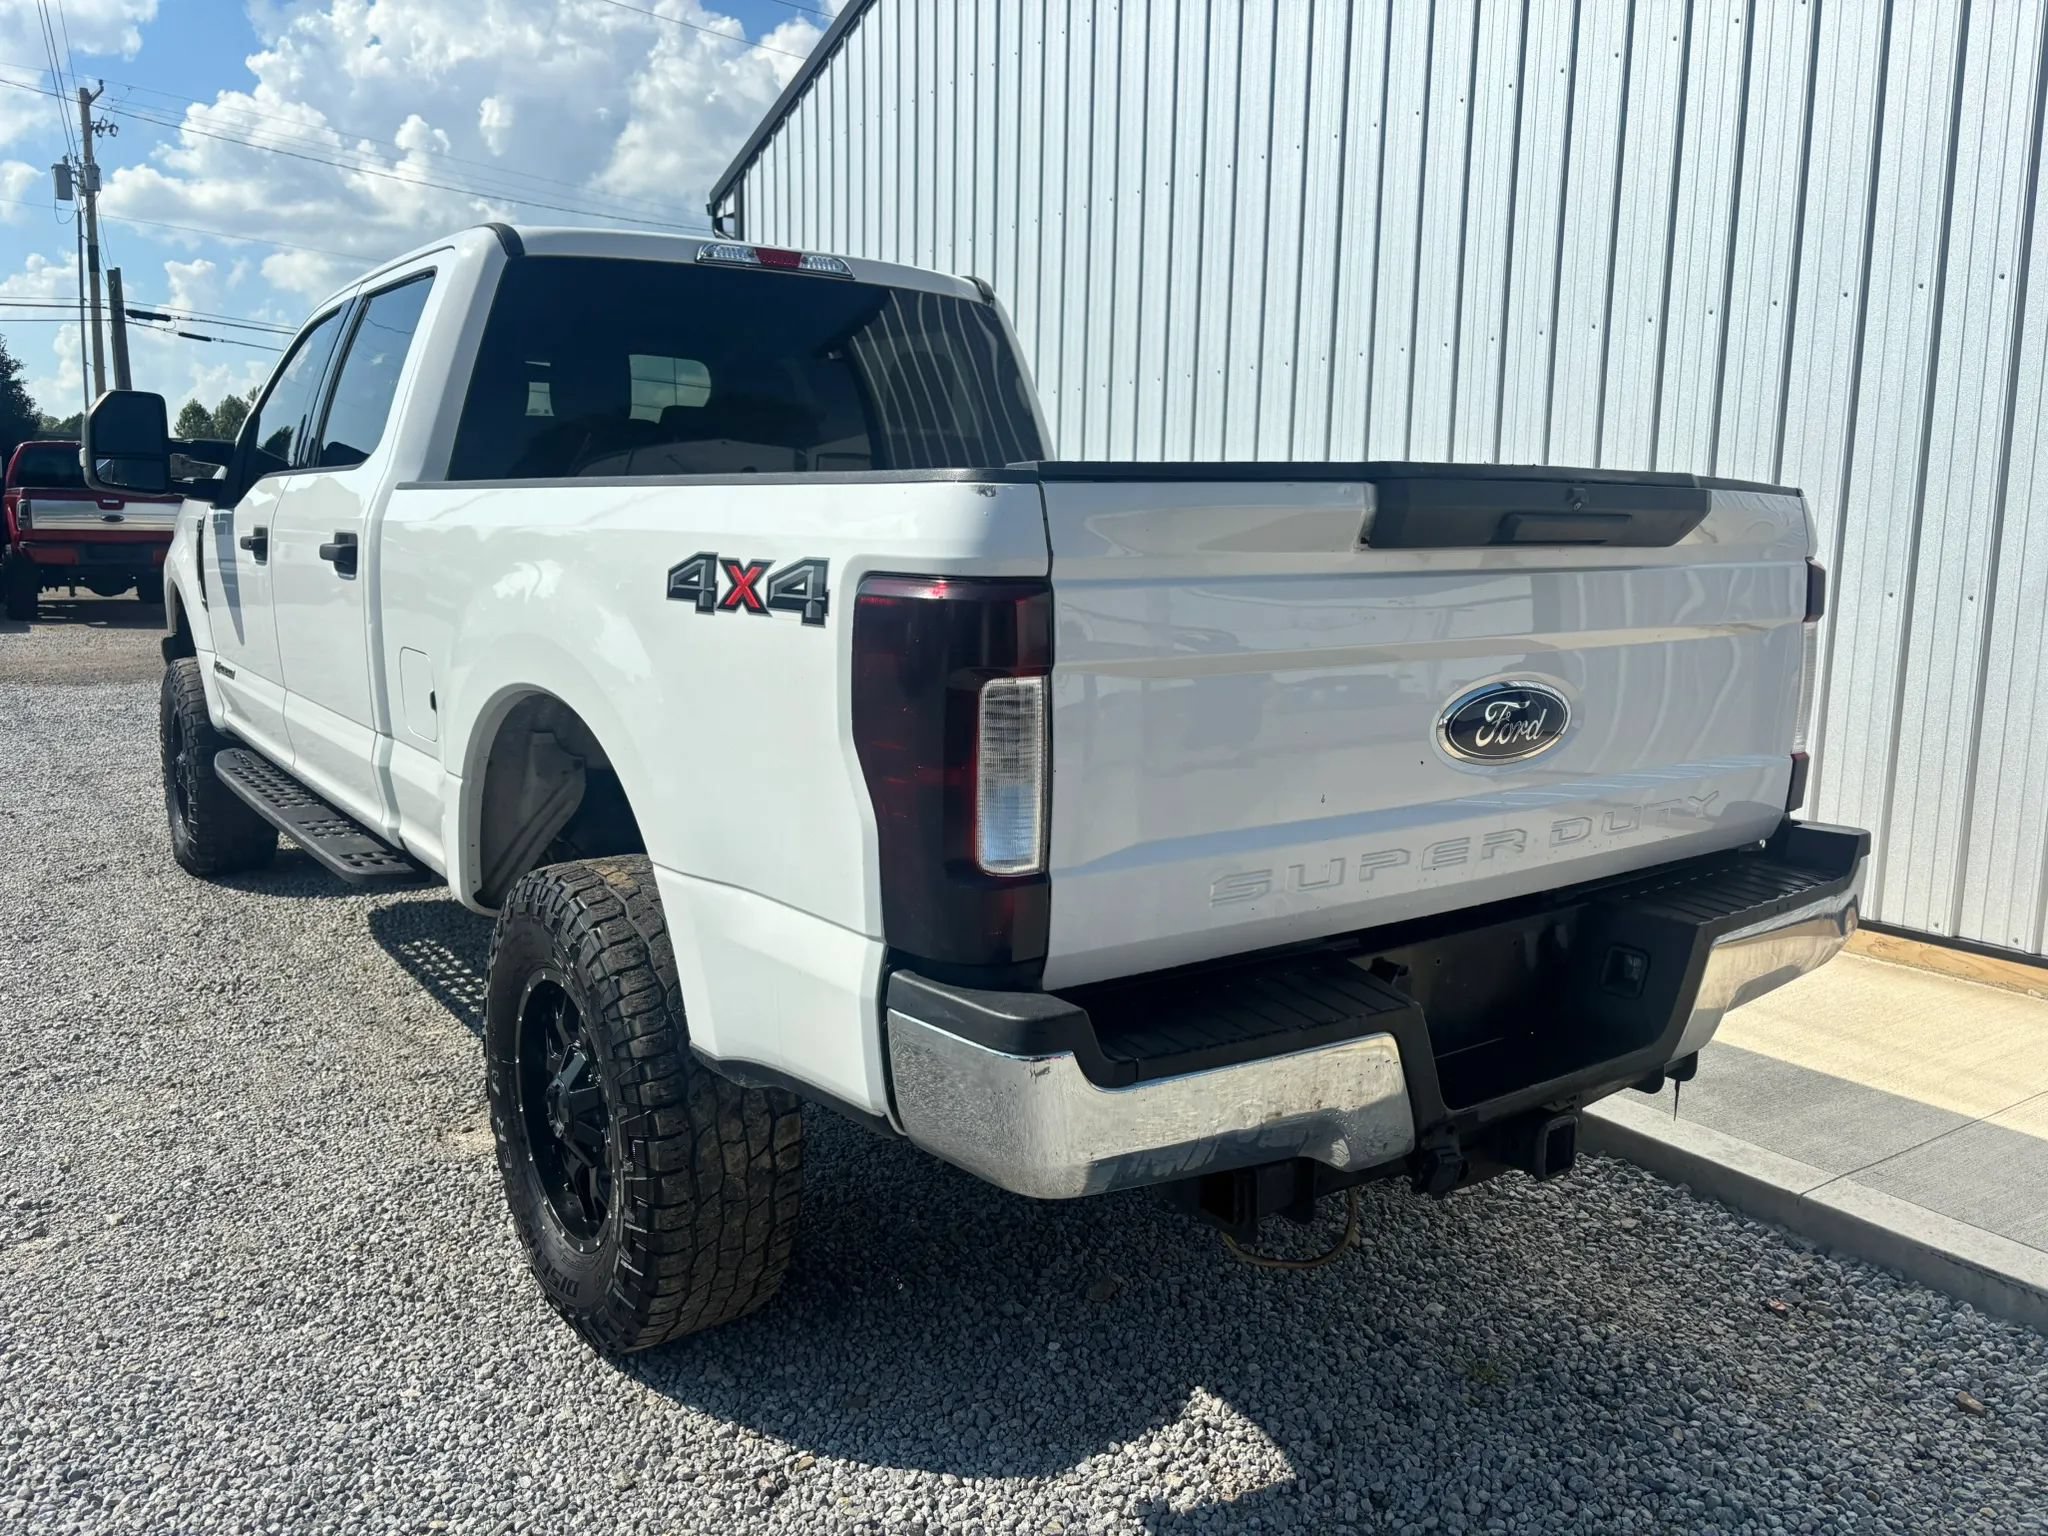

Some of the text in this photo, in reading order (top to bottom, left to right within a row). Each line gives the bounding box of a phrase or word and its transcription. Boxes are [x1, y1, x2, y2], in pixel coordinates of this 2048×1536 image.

[1475, 700, 1548, 747] Ford
[1208, 789, 1720, 908] SUPER DUTY
